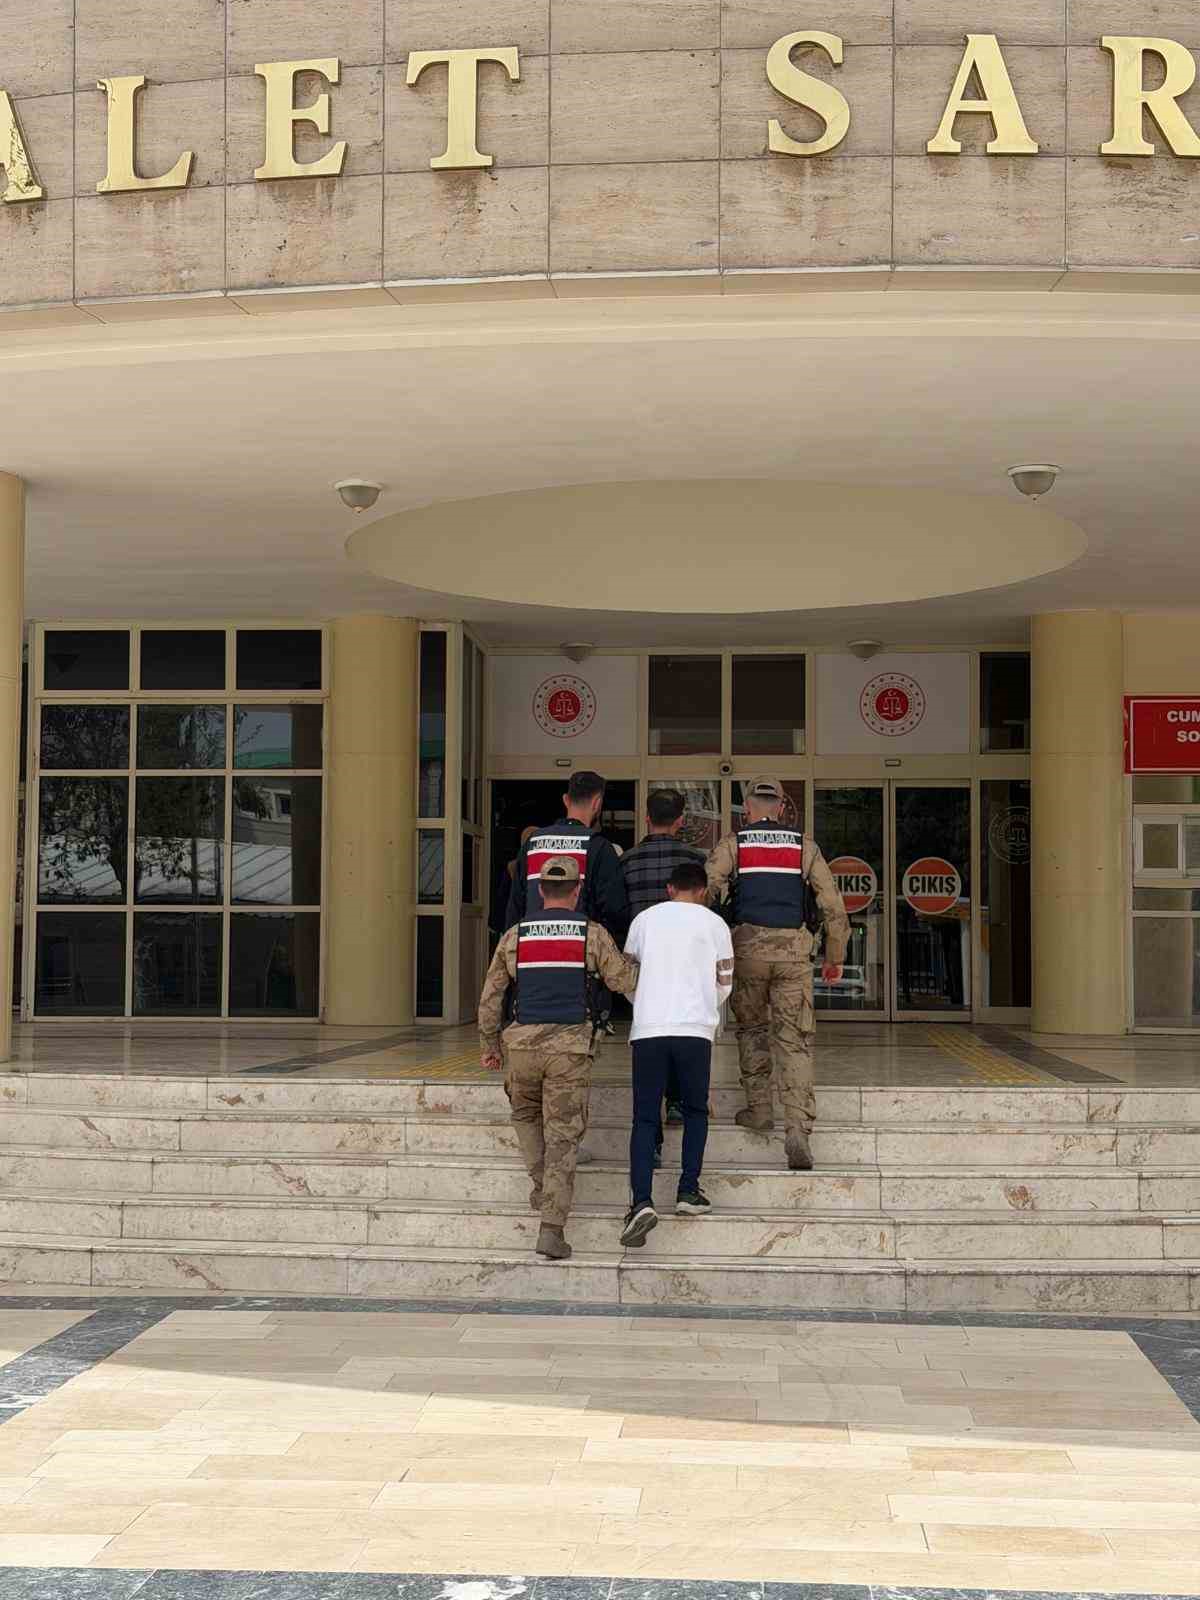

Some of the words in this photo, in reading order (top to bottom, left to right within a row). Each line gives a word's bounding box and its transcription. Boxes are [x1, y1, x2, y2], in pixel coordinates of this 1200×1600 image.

[766, 30, 1200, 157] SAR
[534, 838, 582, 850] JANDARMA
[744, 831, 796, 844] JANDARMA
[833, 875, 872, 895] IKIŞ
[908, 876, 957, 896] ÇIKIŞ
[526, 923, 581, 937] JANDARMA
